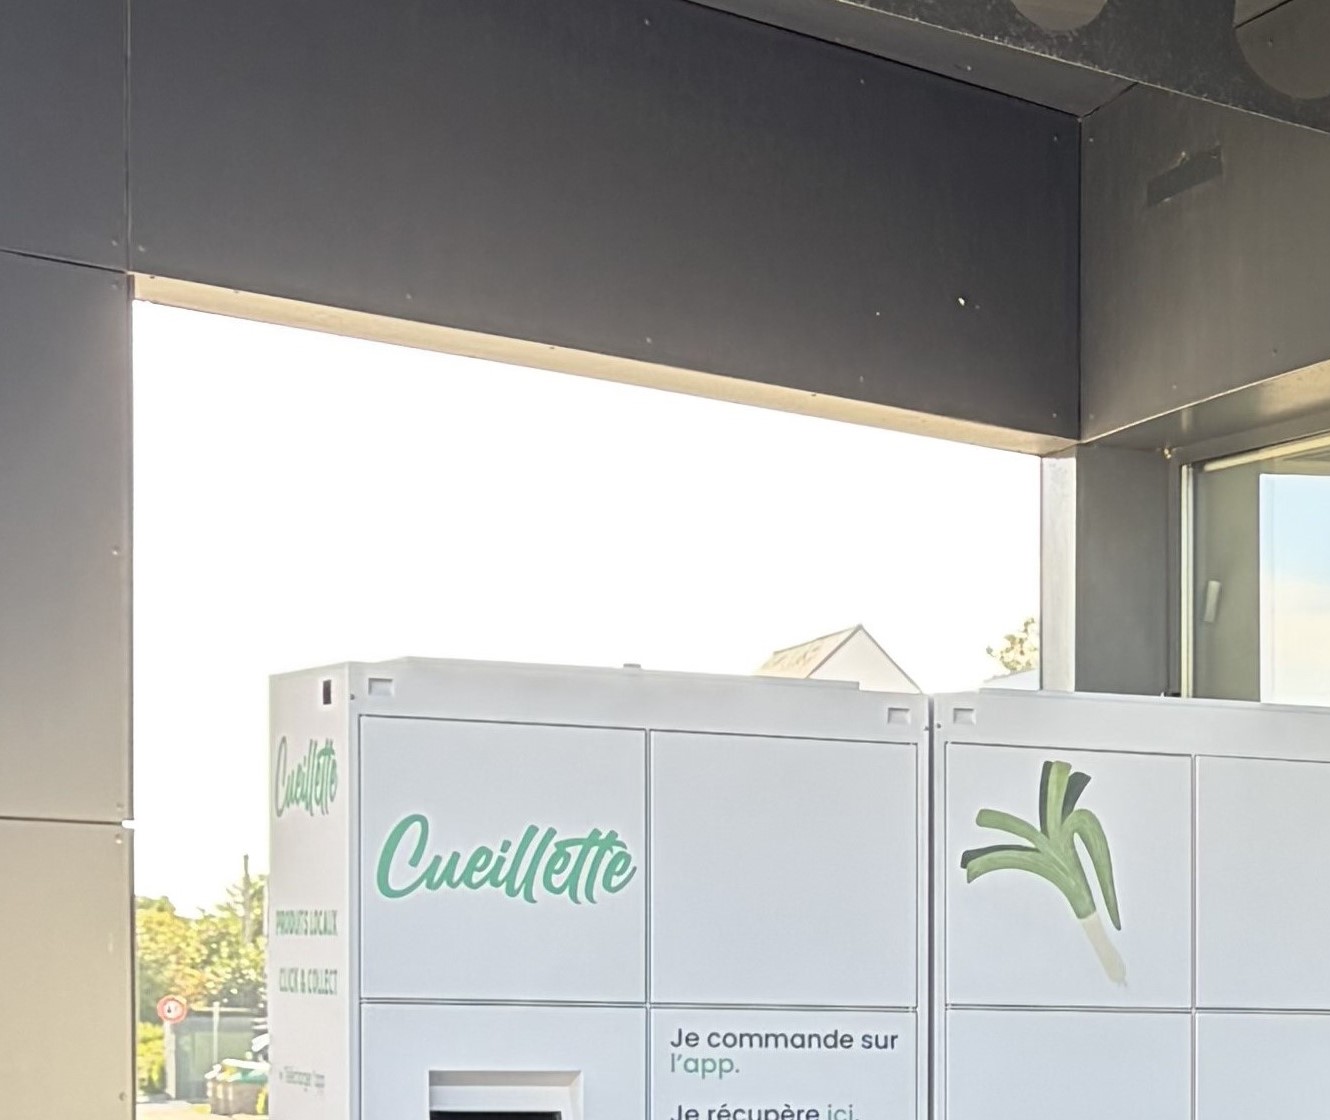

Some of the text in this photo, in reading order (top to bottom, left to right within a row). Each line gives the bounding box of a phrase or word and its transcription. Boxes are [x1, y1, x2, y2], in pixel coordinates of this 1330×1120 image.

[274, 737, 338, 819] Cueillette
[377, 814, 637, 905] Cueillette
[670, 1028, 899, 1050] Je commande sur
[670, 1053, 740, 1080] l'app.
